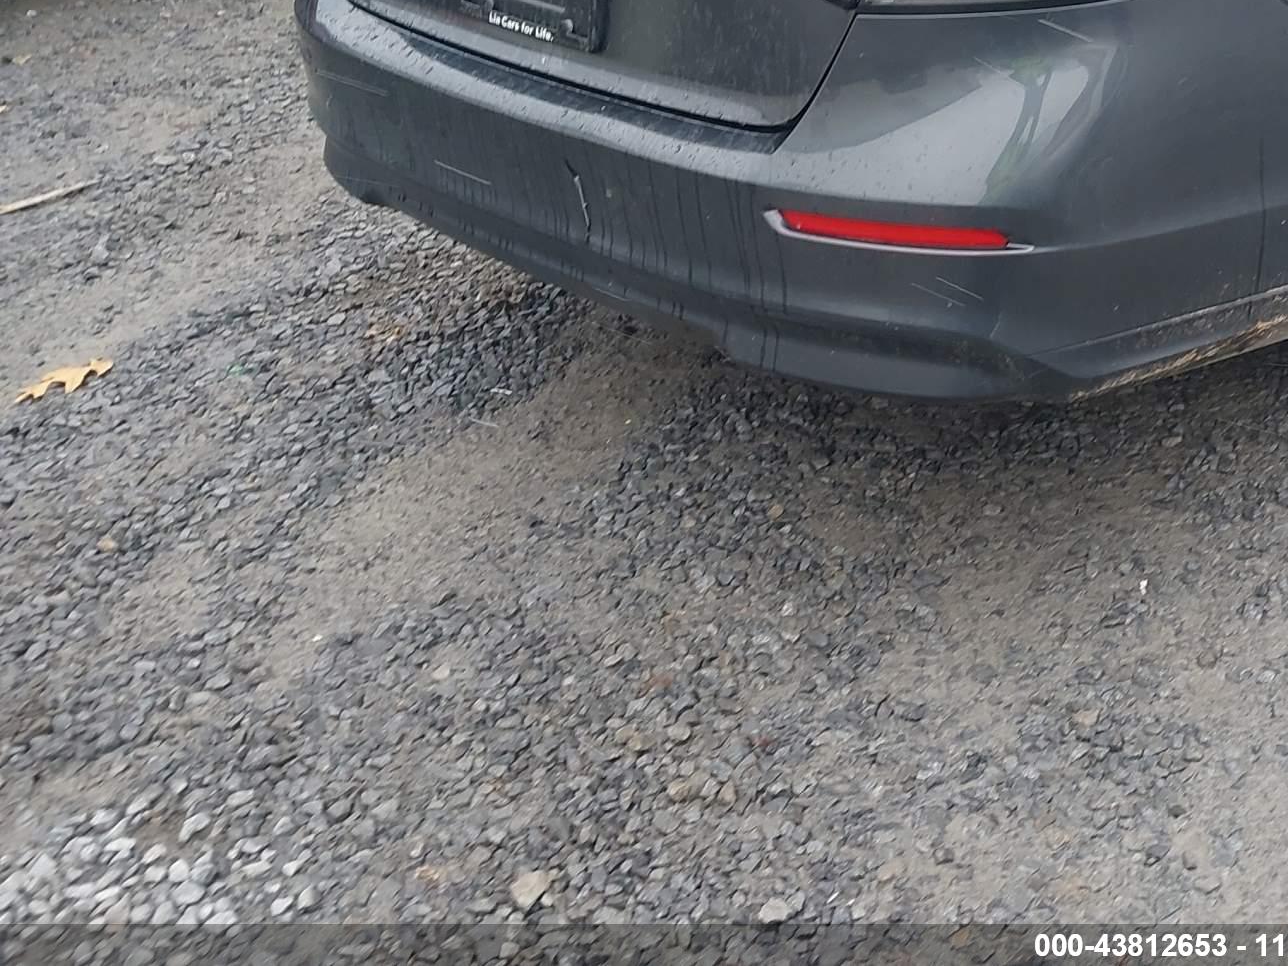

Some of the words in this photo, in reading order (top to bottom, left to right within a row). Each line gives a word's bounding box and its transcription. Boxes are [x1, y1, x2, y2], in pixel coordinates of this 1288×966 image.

[489, 10, 501, 25] Lia
[501, 15, 520, 31] Cars
[521, 21, 535, 35] for
